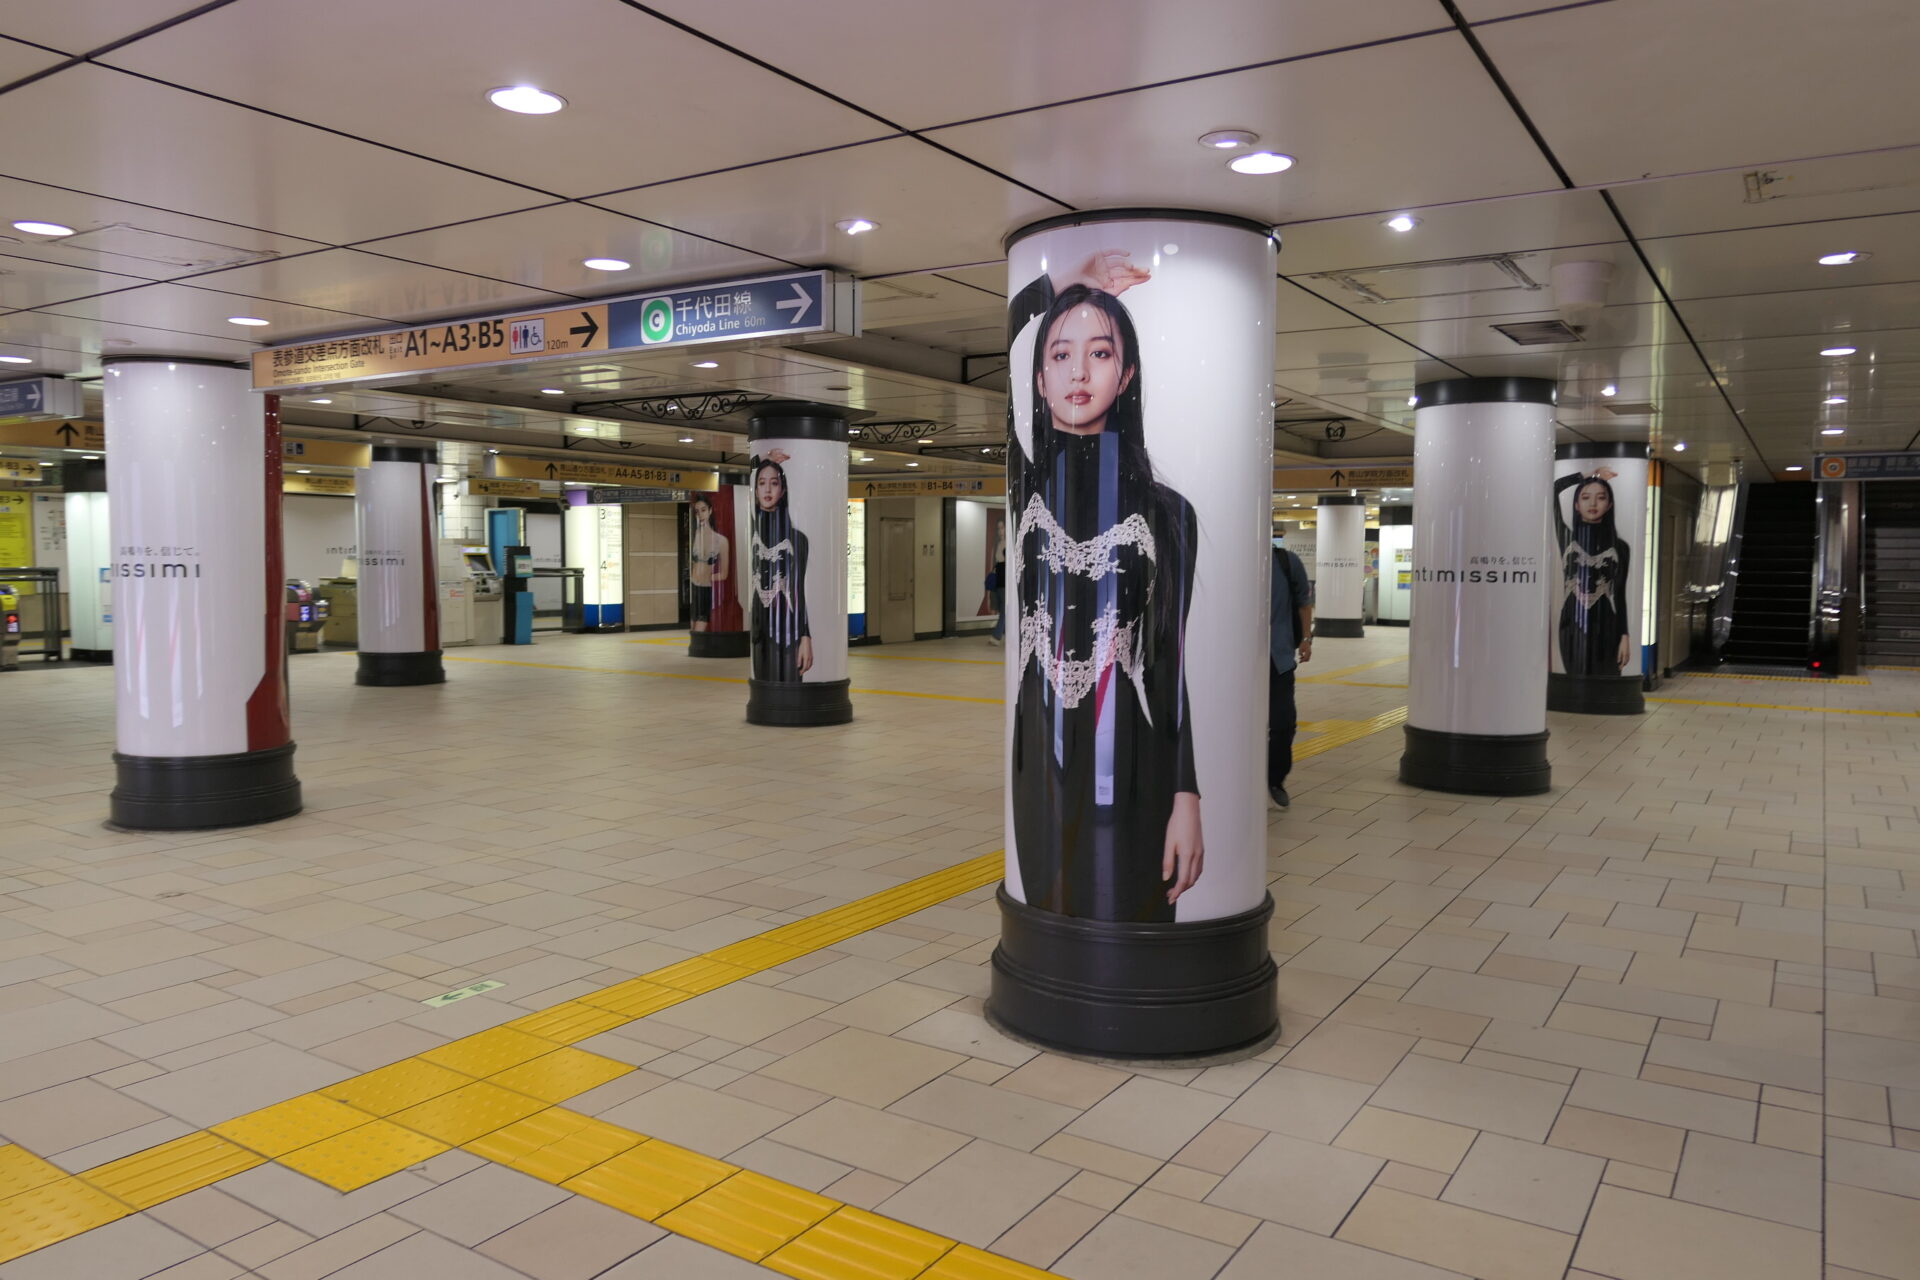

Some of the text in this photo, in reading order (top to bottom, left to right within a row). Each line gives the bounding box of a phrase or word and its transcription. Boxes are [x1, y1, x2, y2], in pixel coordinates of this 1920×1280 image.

[676, 290, 752, 322] 千代田線
[652, 313, 661, 328] C
[675, 316, 766, 337] Chiyoda Line 60m
[273, 335, 385, 368] 表参道交差点方面改札
[546, 339, 569, 351] 120m
[273, 365, 312, 379] Omote-sando
[313, 361, 349, 373] Intersection
[350, 359, 365, 370] Gate
